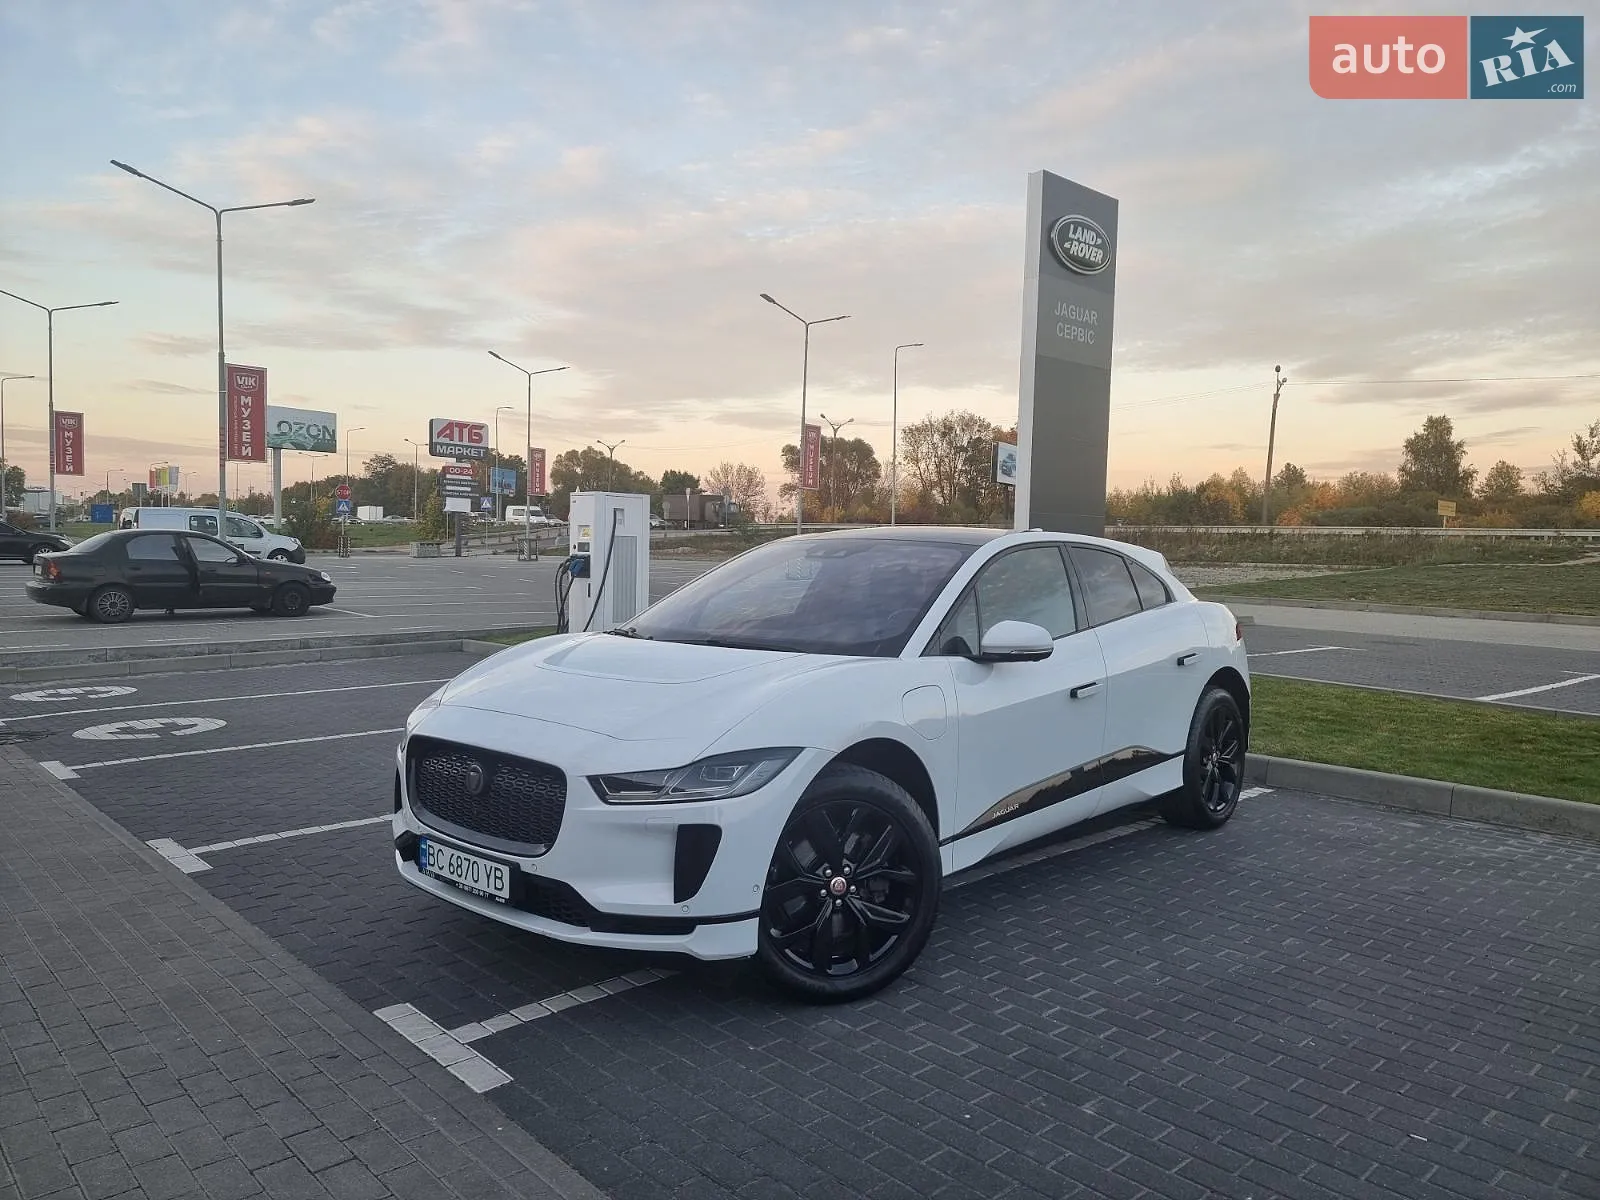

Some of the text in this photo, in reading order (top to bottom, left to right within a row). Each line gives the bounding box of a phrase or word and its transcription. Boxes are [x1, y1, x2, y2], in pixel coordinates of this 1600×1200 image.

[1068, 224, 1096, 245] LAND
[1069, 240, 1104, 264] ROVER
[1055, 302, 1098, 325] JAGUAR
[1056, 322, 1096, 345] СЕРВІС
[236, 375, 256, 386] VIK
[240, 395, 252, 457] МУЗЕЙ
[277, 420, 336, 439] OZON
[436, 420, 485, 444] АТБ
[64, 431, 73, 472] МУЗЕЙ
[436, 445, 486, 457] МАРКЕТ
[992, 803, 1019, 819] JAGUAR
[427, 844, 445, 871] BC
[448, 853, 480, 884] 6870
